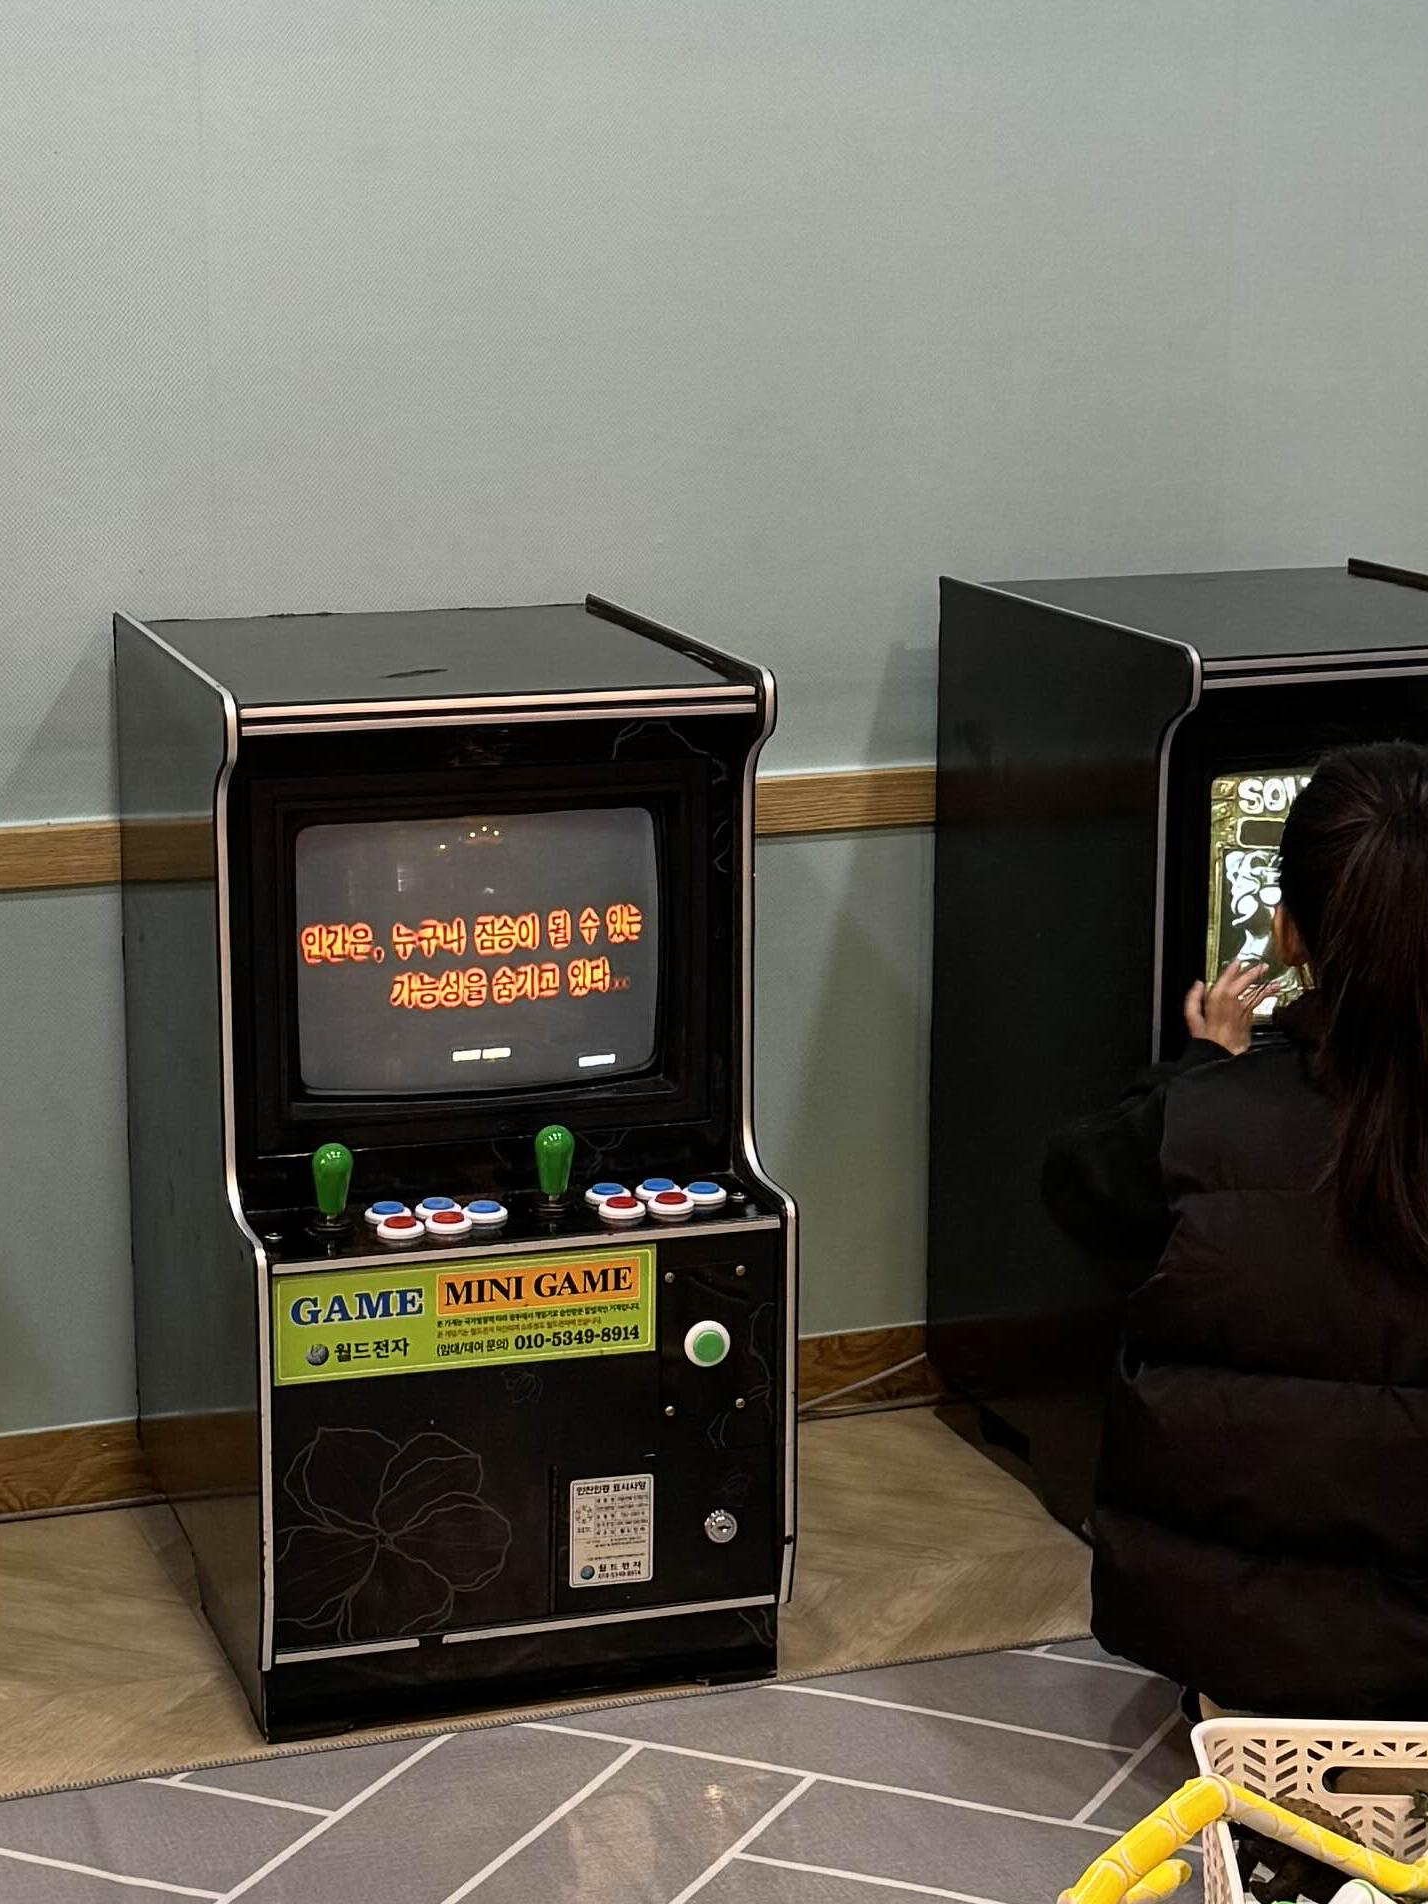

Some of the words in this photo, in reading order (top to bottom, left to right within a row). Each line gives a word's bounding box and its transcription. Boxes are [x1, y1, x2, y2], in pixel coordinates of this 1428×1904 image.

[301, 922, 385, 965] 인간은,
[391, 917, 467, 960] 누구나
[474, 912, 540, 956] 짐승이
[547, 909, 572, 949] 될
[578, 906, 600, 945] 수
[606, 904, 643, 944] 있는
[390, 968, 488, 1009] 가능성을
[492, 962, 560, 1005] 숨기고
[445, 1276, 525, 1306] MINI
[533, 1266, 633, 1298] GAME
[290, 1287, 424, 1326] GAME
[334, 1337, 410, 1362] 월드전자
[514, 1325, 640, 1350] 010-5349-8914
